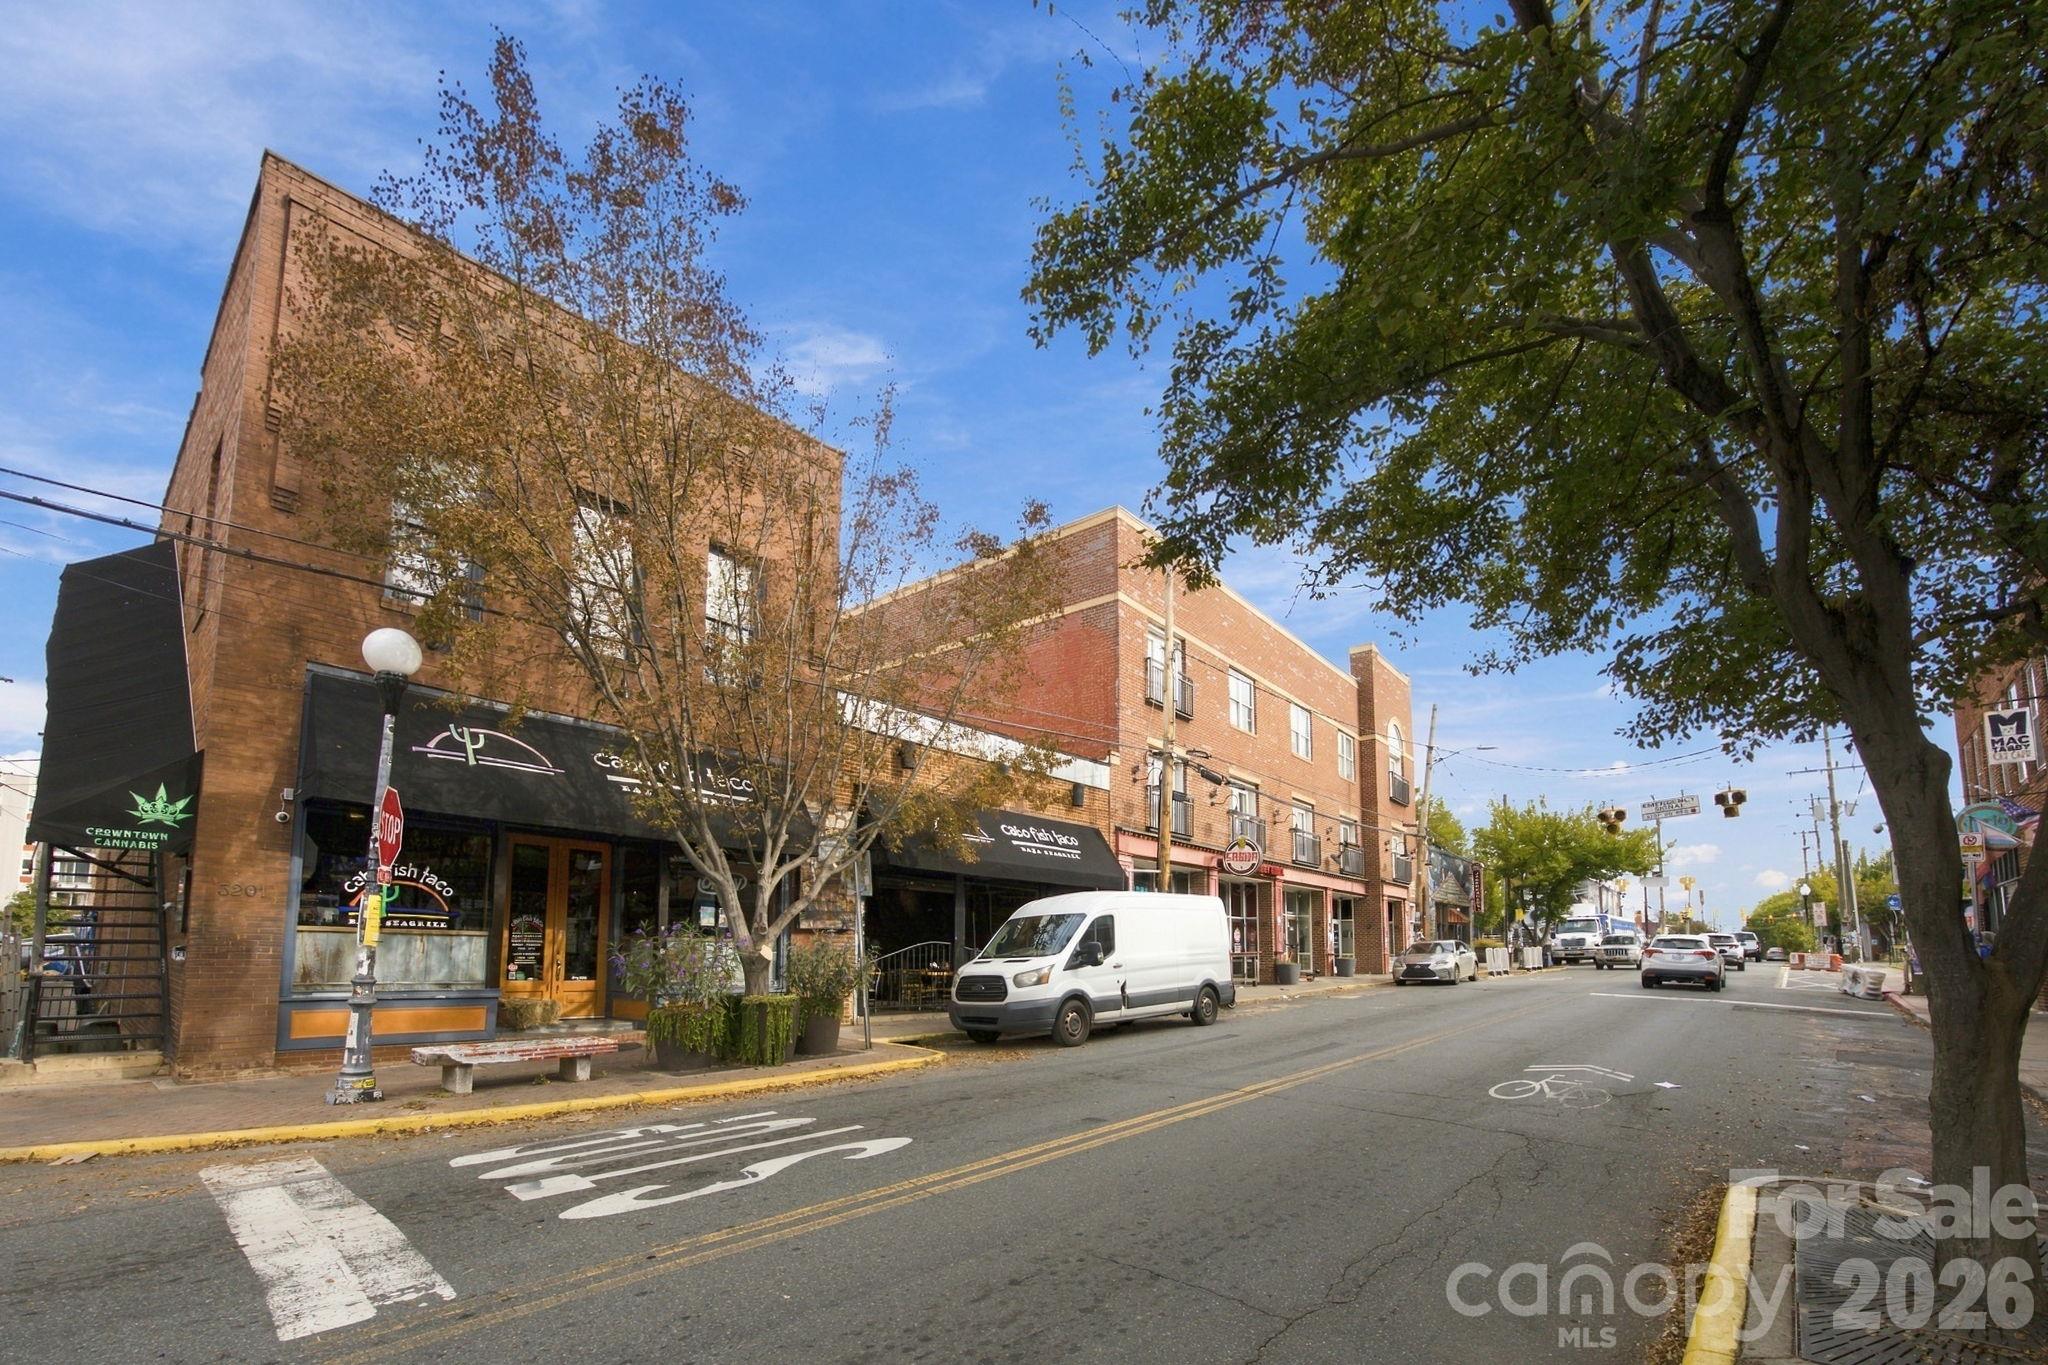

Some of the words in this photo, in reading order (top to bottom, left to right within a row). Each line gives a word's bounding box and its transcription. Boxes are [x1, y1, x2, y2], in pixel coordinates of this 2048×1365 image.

[1991, 735, 2030, 747] MAC
[1992, 744, 2030, 753] TABBY
[1642, 797, 1695, 808] EMERGENCY
[1655, 803, 1684, 812] SIGNAL
[85, 827, 169, 841] CROWNTOWN
[380, 811, 401, 845] STOP
[1000, 824, 1031, 839] cabo
[1030, 827, 1053, 843] fish
[1052, 830, 1079, 846] taco
[94, 837, 159, 850] CANNABIS
[391, 862, 418, 878] ish
[419, 865, 454, 897] taco
[385, 920, 448, 928] SEAGRILL
